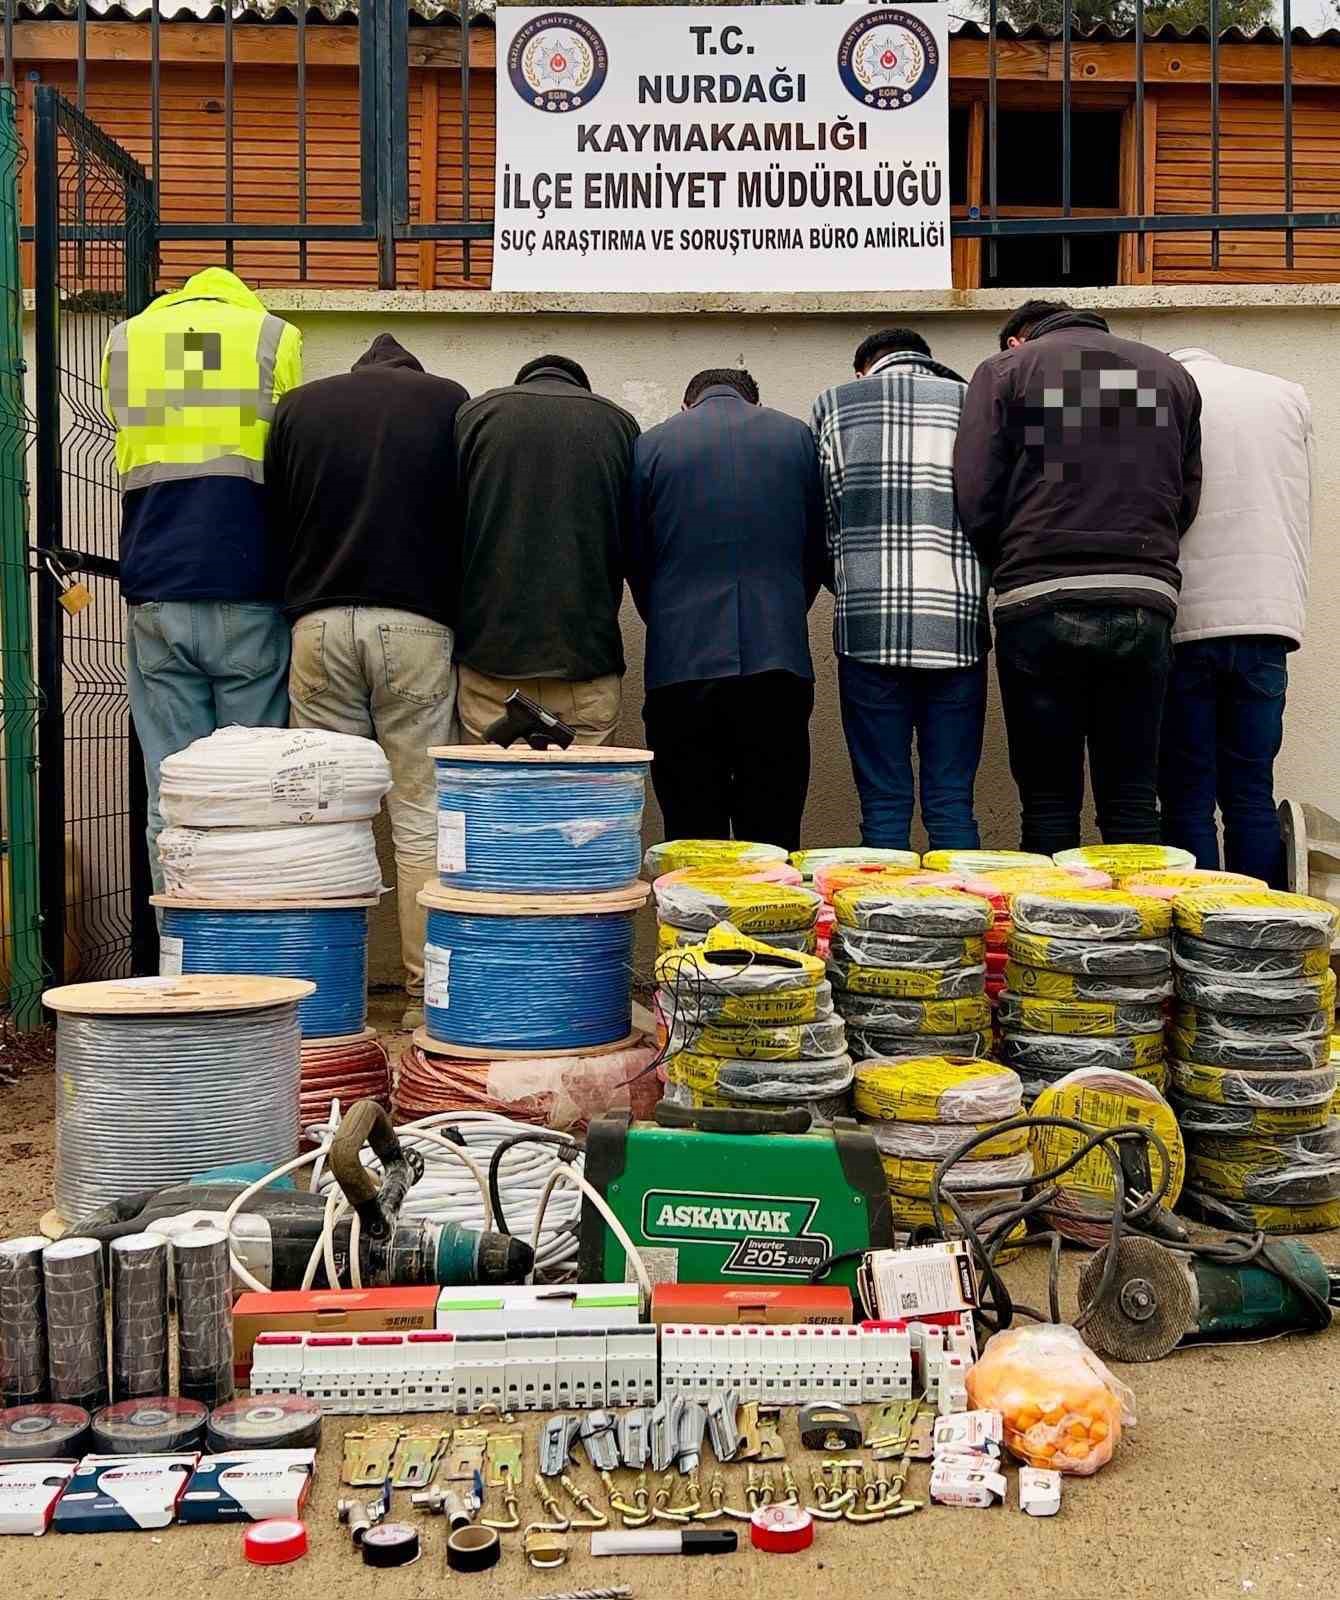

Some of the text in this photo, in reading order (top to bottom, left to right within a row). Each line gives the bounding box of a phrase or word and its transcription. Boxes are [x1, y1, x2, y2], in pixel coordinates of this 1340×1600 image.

[689, 25, 755, 55] T.C.
[638, 66, 806, 104] NURDAĞI
[576, 114, 867, 153] KAYMAKAMLIĞI
[503, 161, 942, 219] İLÇE EMNİYET MÜDÜRLÜĞÜ
[500, 221, 945, 257] SUÇ ARAŞTIRMA VE SORUŞTURMA BÜRO AMİRLİĞİ
[655, 1204, 792, 1234] ASKAYNAK
[743, 1250, 821, 1267] 205 SUPER
[748, 1239, 785, 1251] Inverter
